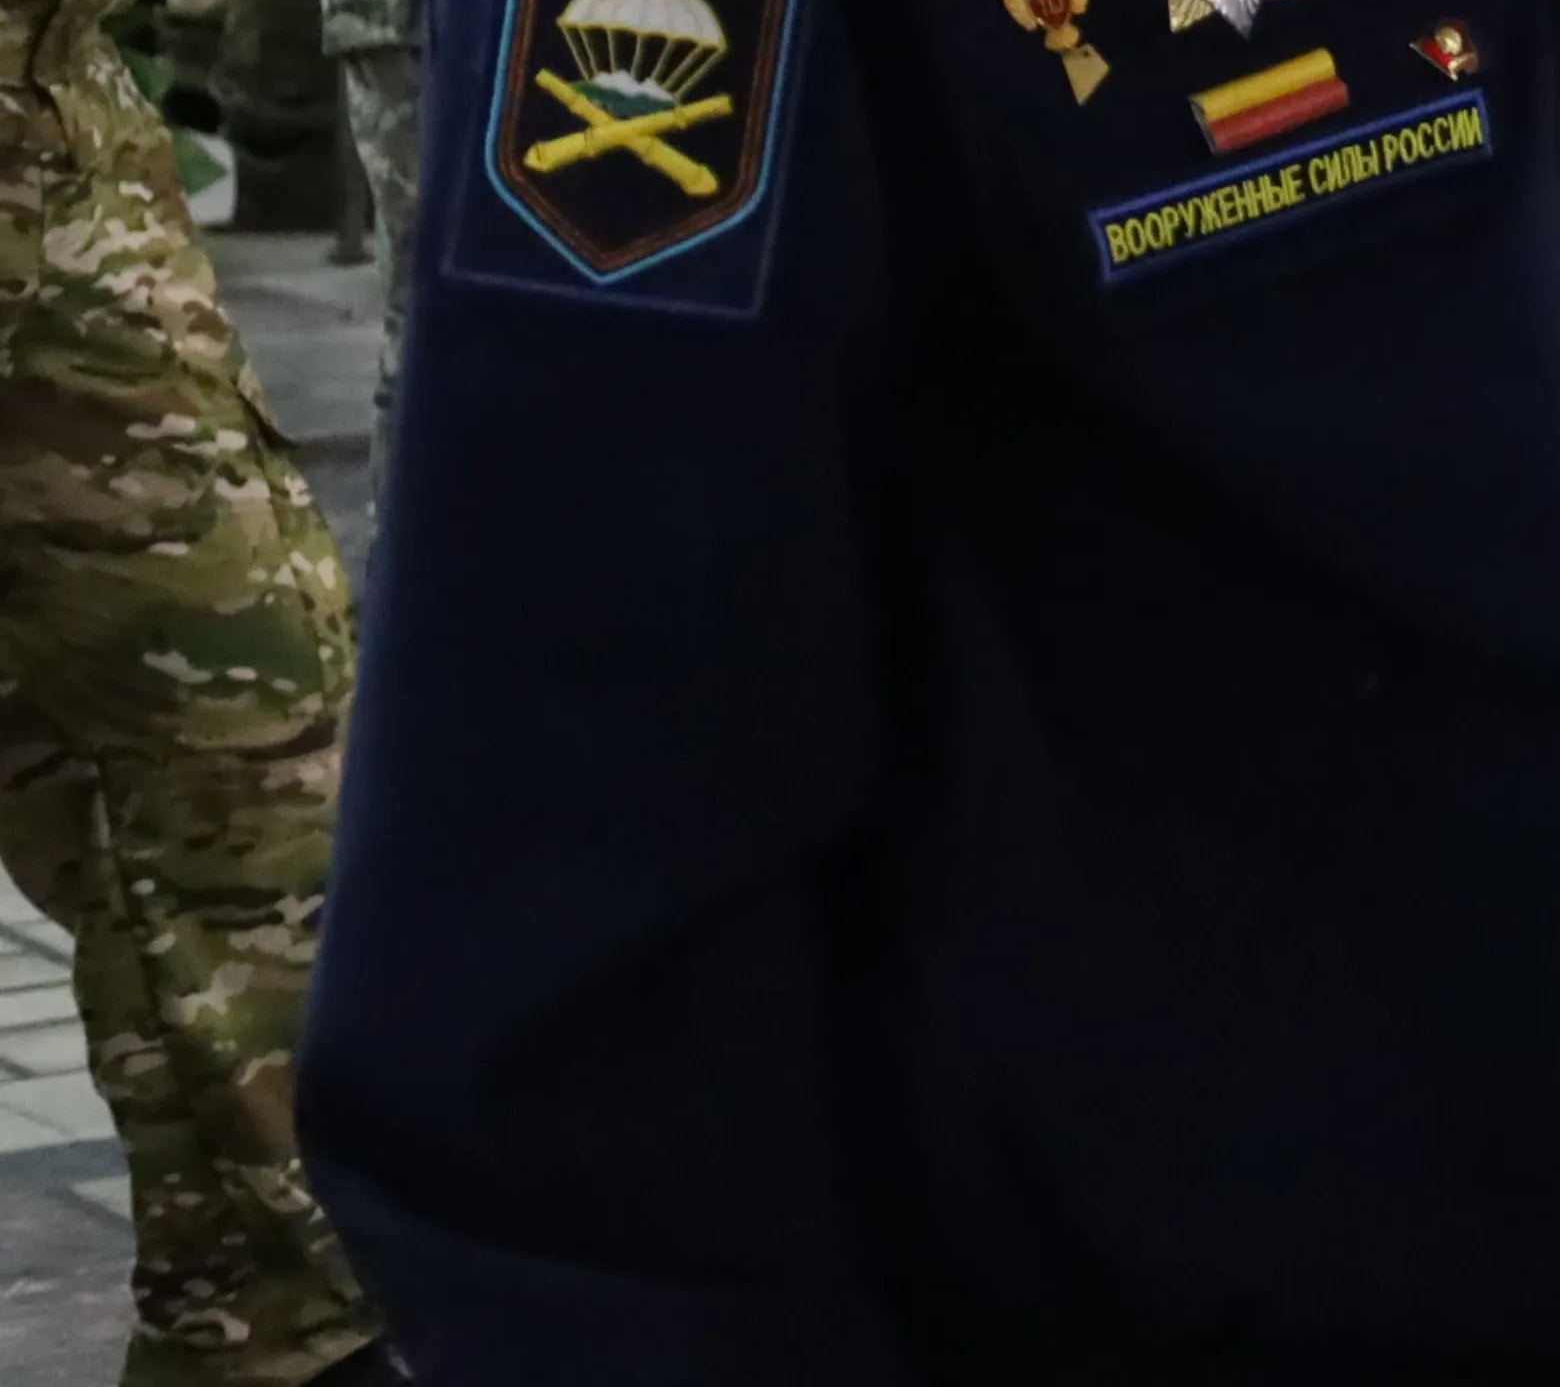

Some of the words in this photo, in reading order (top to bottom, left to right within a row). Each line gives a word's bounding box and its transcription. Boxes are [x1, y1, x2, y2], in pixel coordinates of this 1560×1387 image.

[1105, 163, 1306, 264] ВООРУЖЕННЫЕ
[1309, 139, 1378, 195] СИЛЫ
[1383, 107, 1484, 174] РОССИИ
